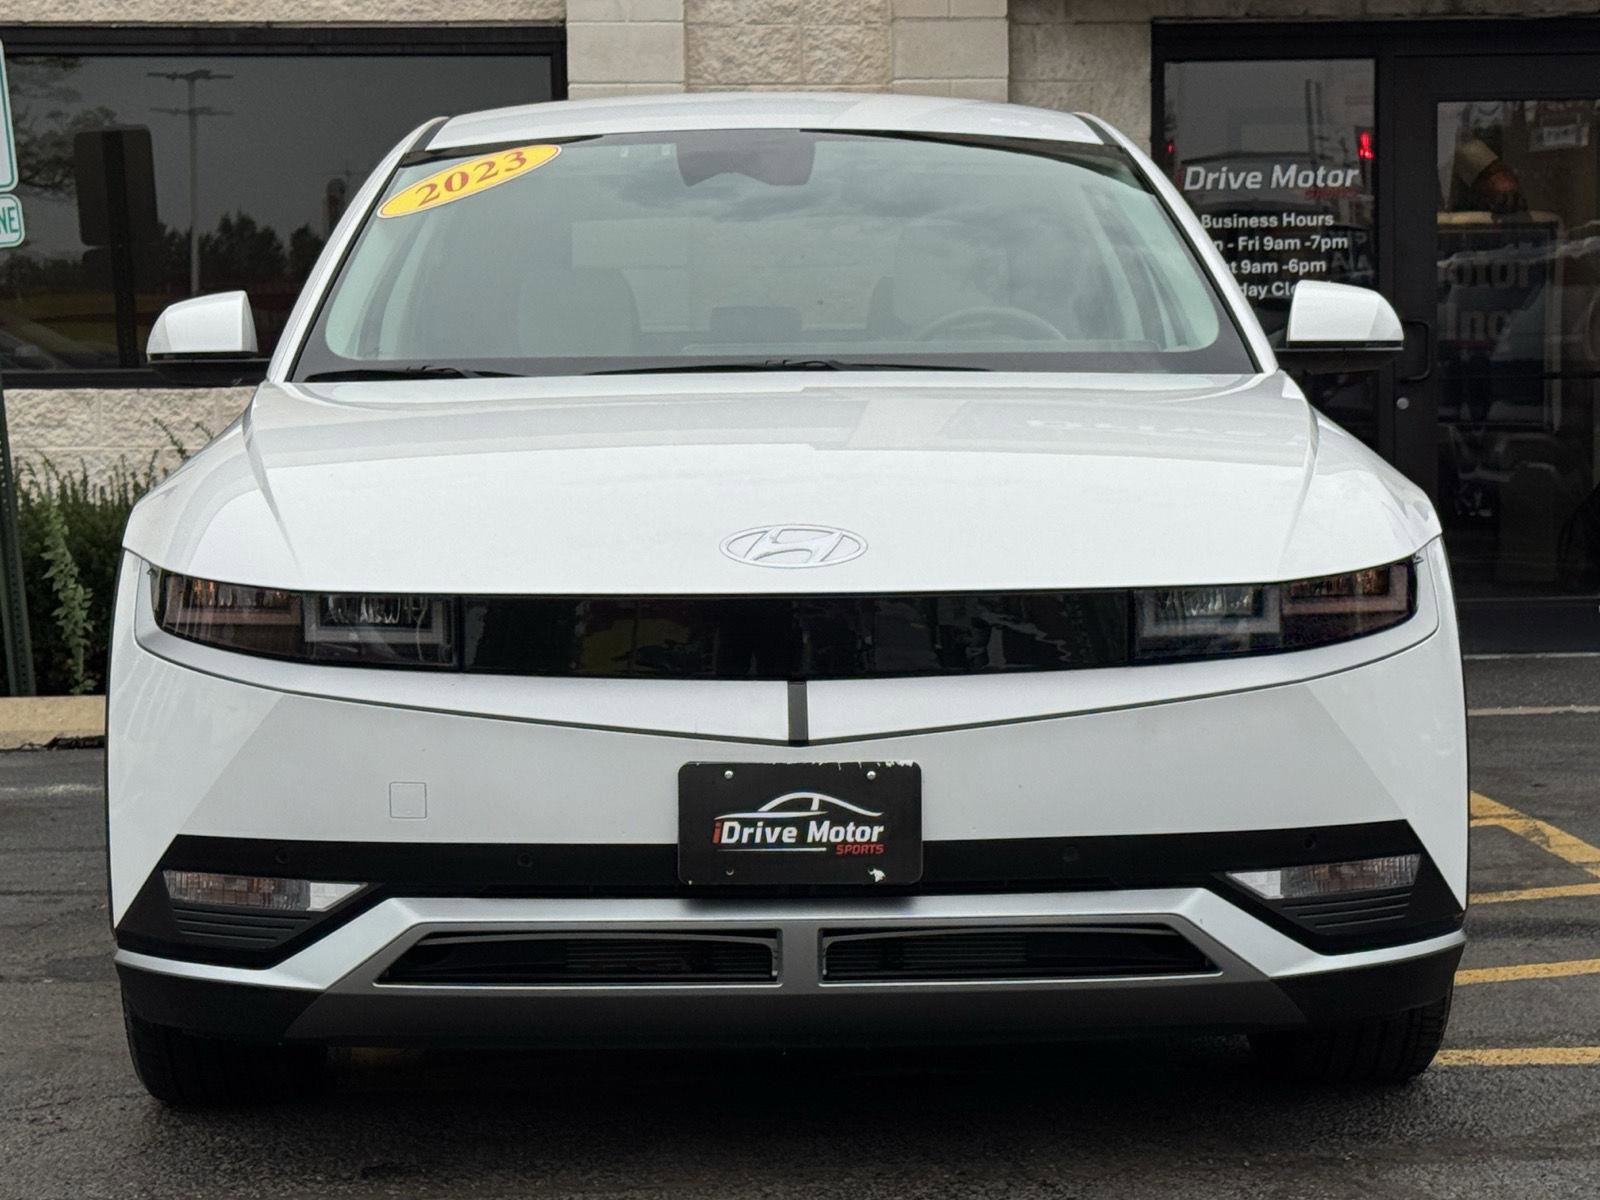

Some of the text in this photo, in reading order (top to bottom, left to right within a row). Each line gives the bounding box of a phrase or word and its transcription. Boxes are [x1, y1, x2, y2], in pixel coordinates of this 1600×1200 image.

[416, 151, 527, 207] 2023
[1270, 164, 1360, 189] Motor
[0, 206, 19, 234] NE
[1201, 212, 1335, 229] Business Hours
[1237, 236, 1260, 251] Fri
[1263, 236, 1301, 251] 9am
[1240, 259, 1279, 274] 9am
[711, 820, 885, 844] iDrive Motor
[835, 844, 885, 855] SPORTS
